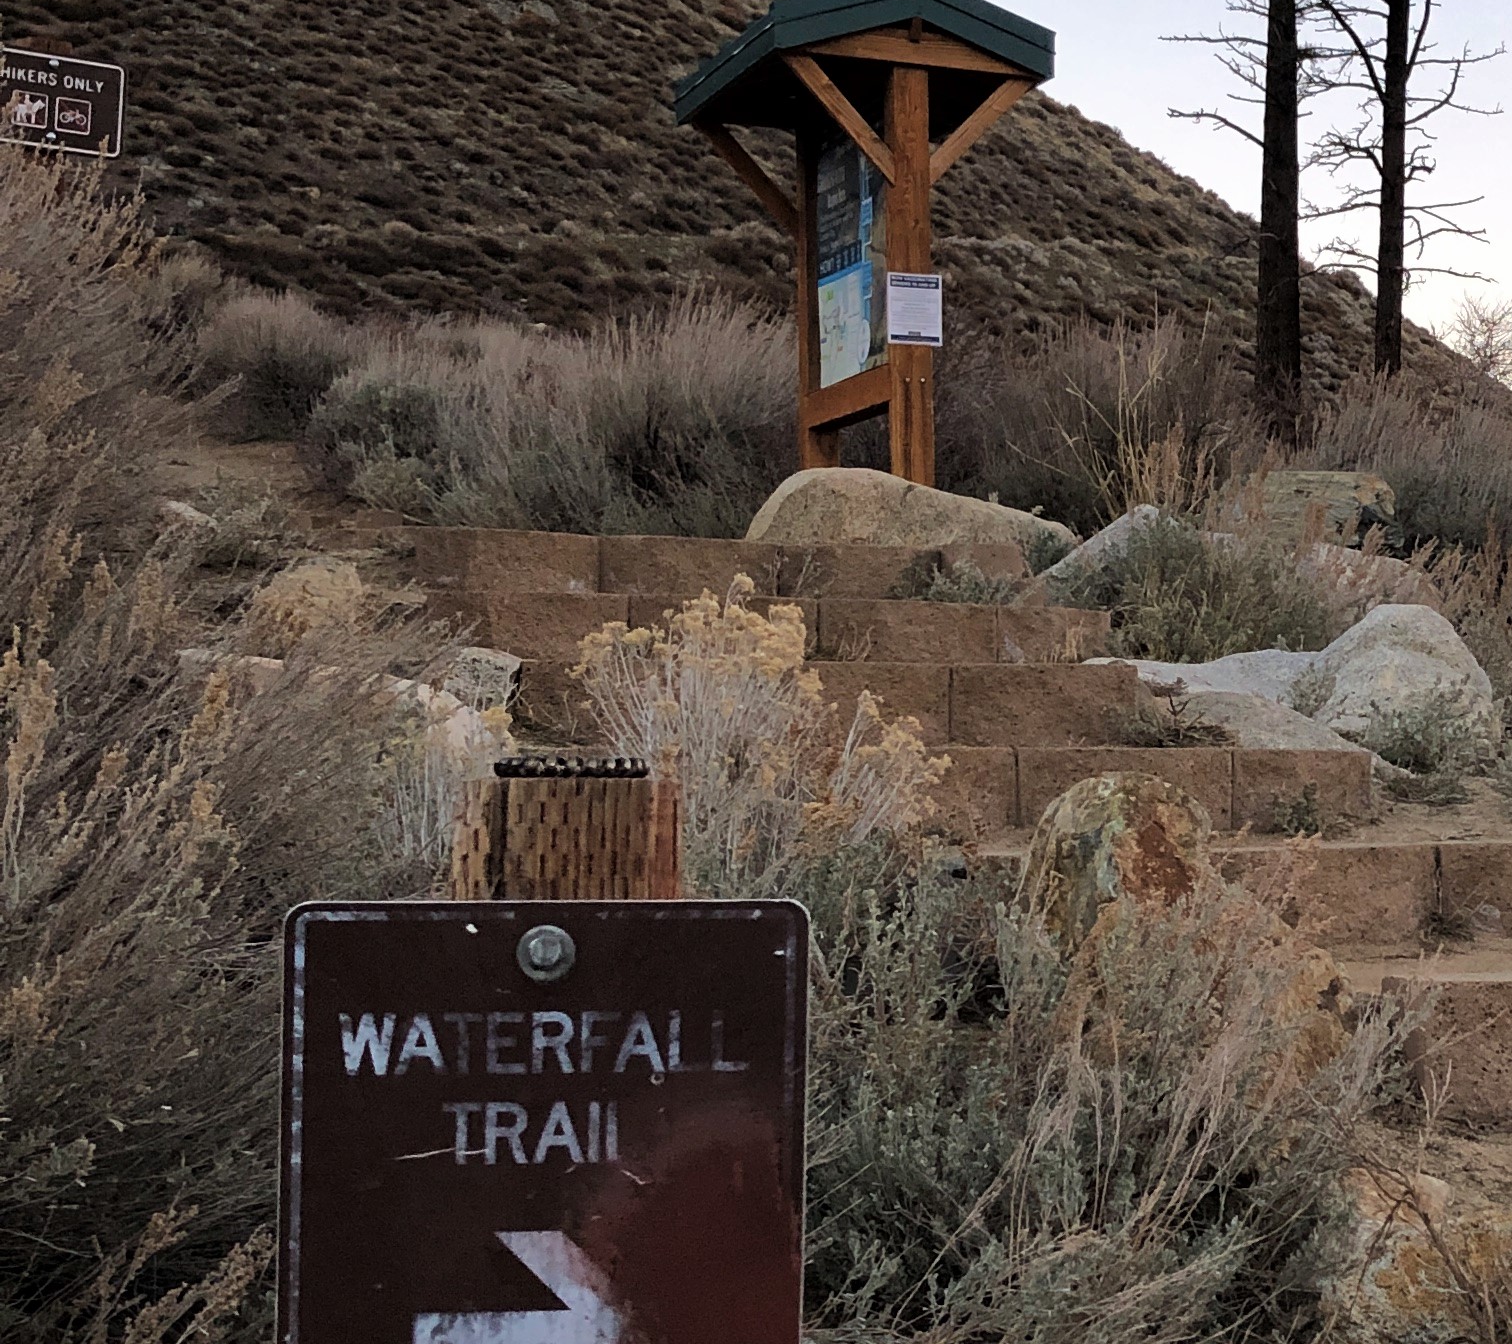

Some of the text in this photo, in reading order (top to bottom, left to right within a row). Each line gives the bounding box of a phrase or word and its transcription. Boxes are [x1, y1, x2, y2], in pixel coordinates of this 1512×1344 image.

[0, 66, 105, 94] HIKERS ONLY
[338, 1009, 751, 1076] WATERFALL
